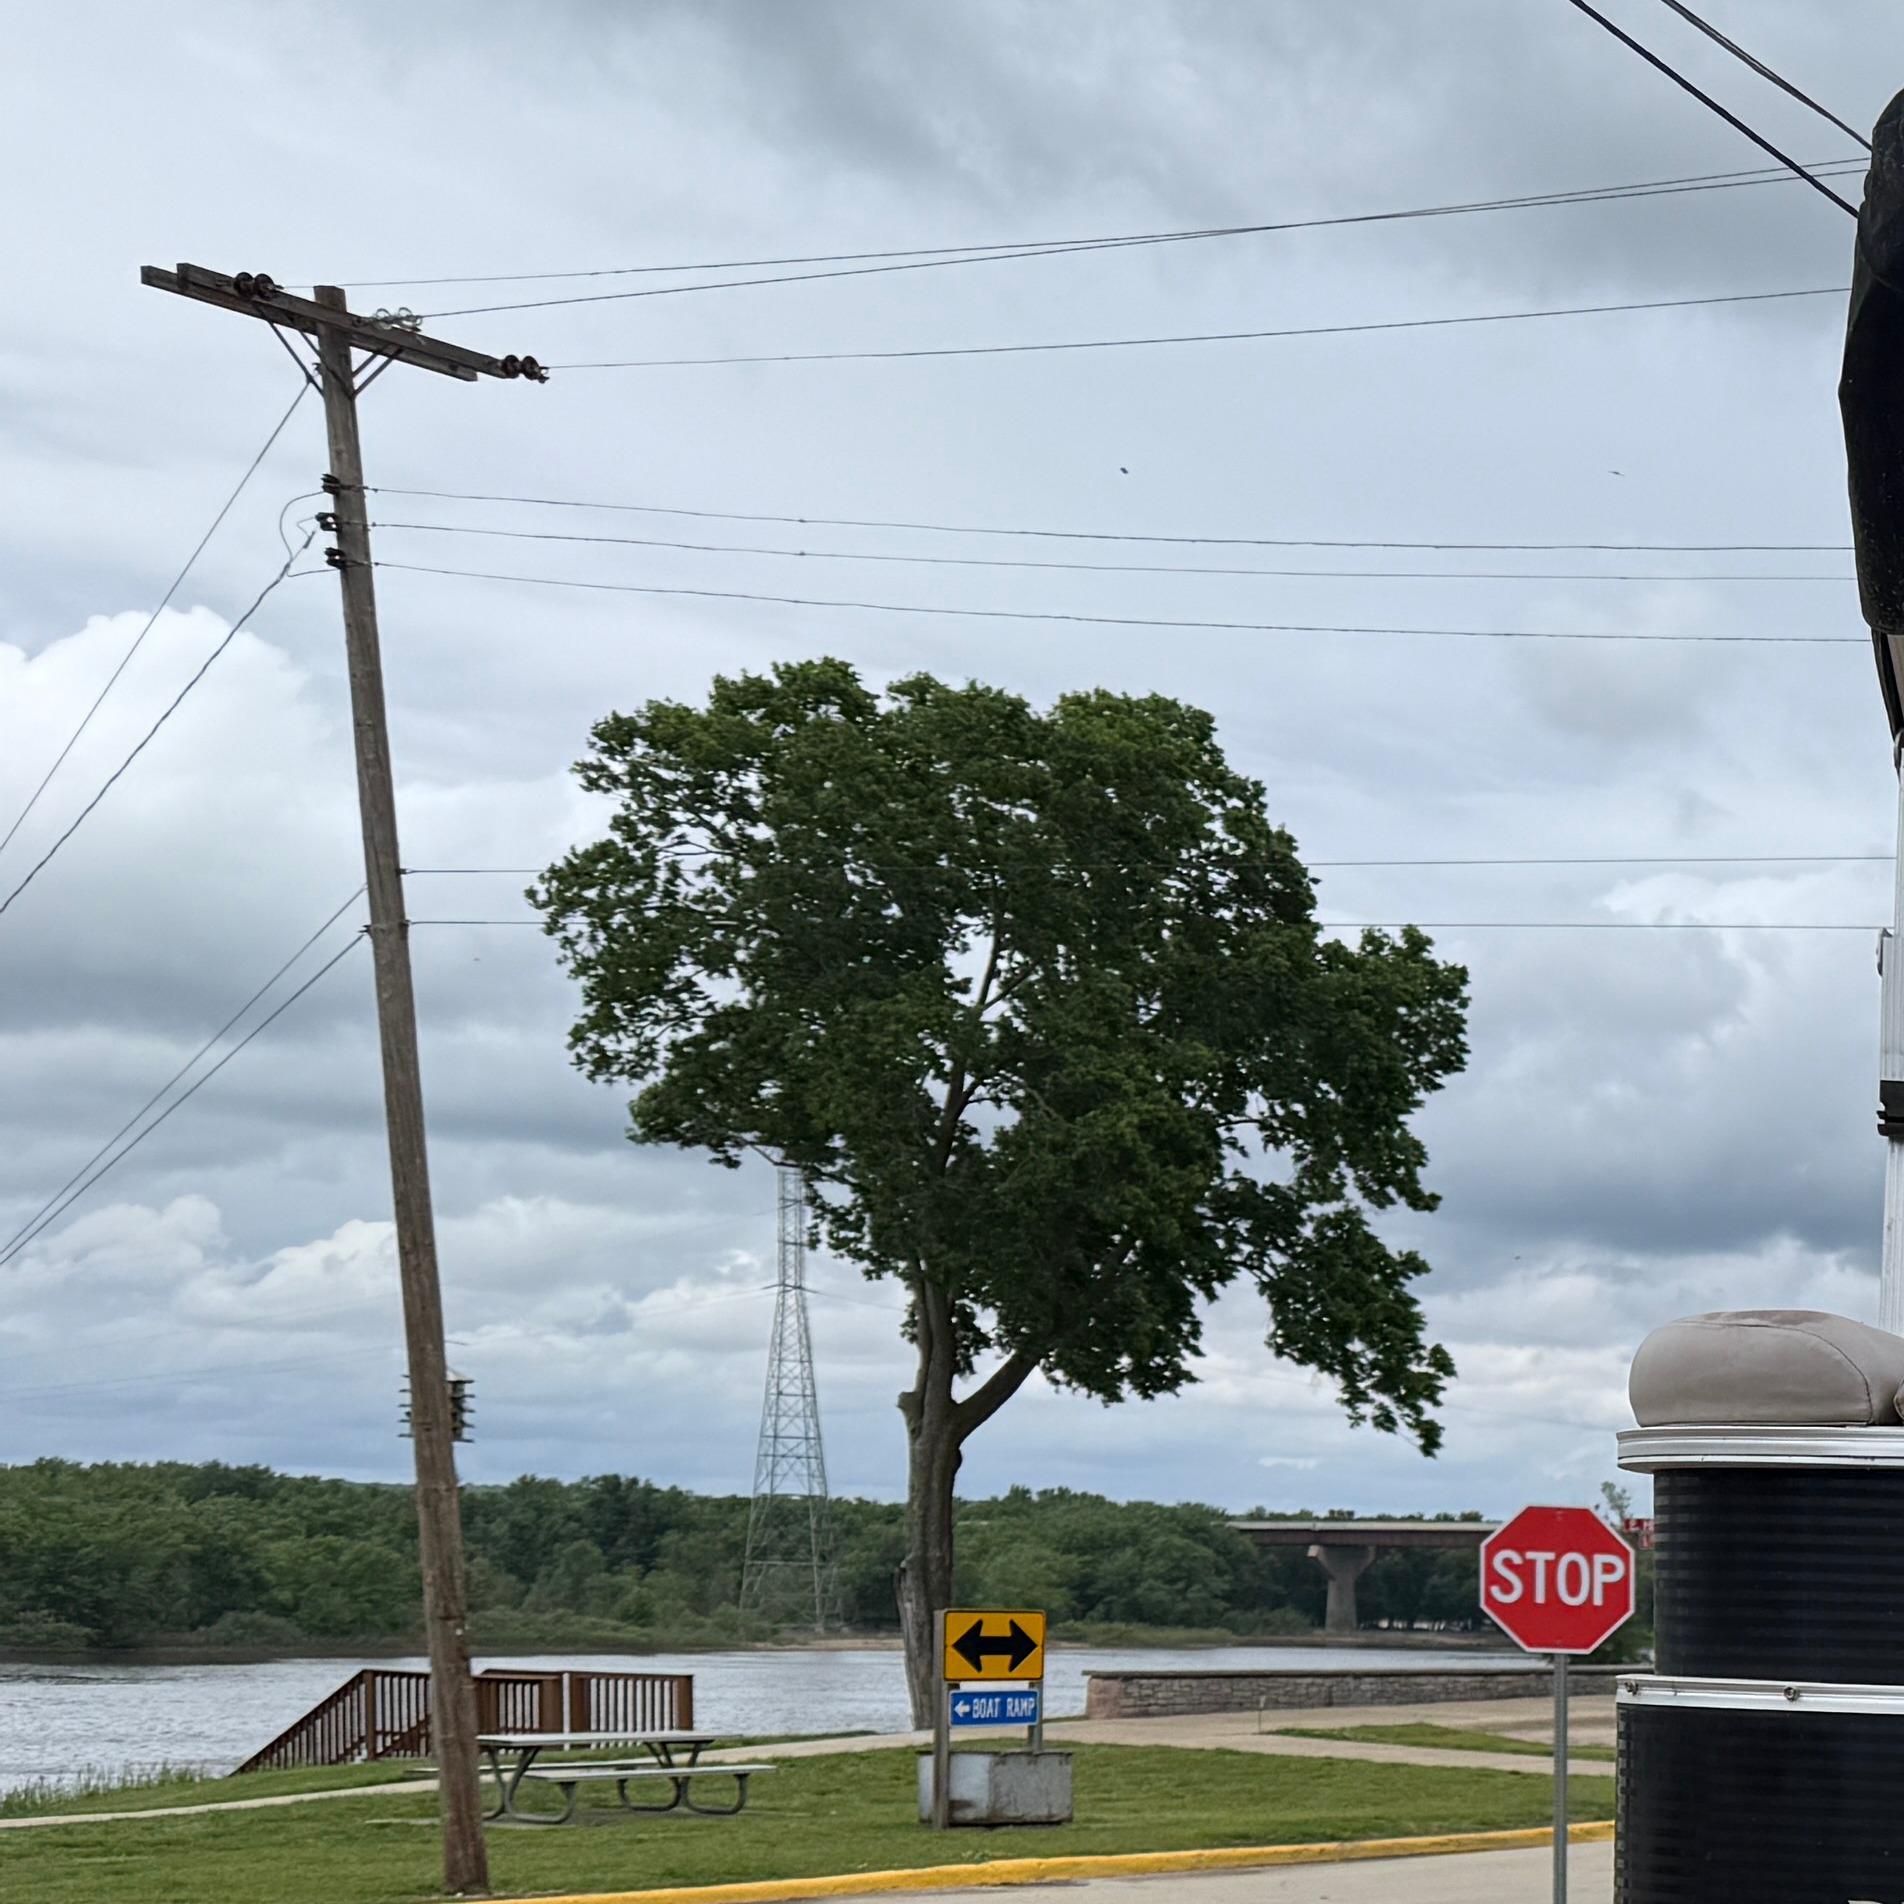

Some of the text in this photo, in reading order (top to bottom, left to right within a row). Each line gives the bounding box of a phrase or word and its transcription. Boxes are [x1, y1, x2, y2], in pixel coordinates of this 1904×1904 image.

[1490, 1549, 1625, 1607] STOP
[972, 1697, 1036, 1718] BOAT RAMP
